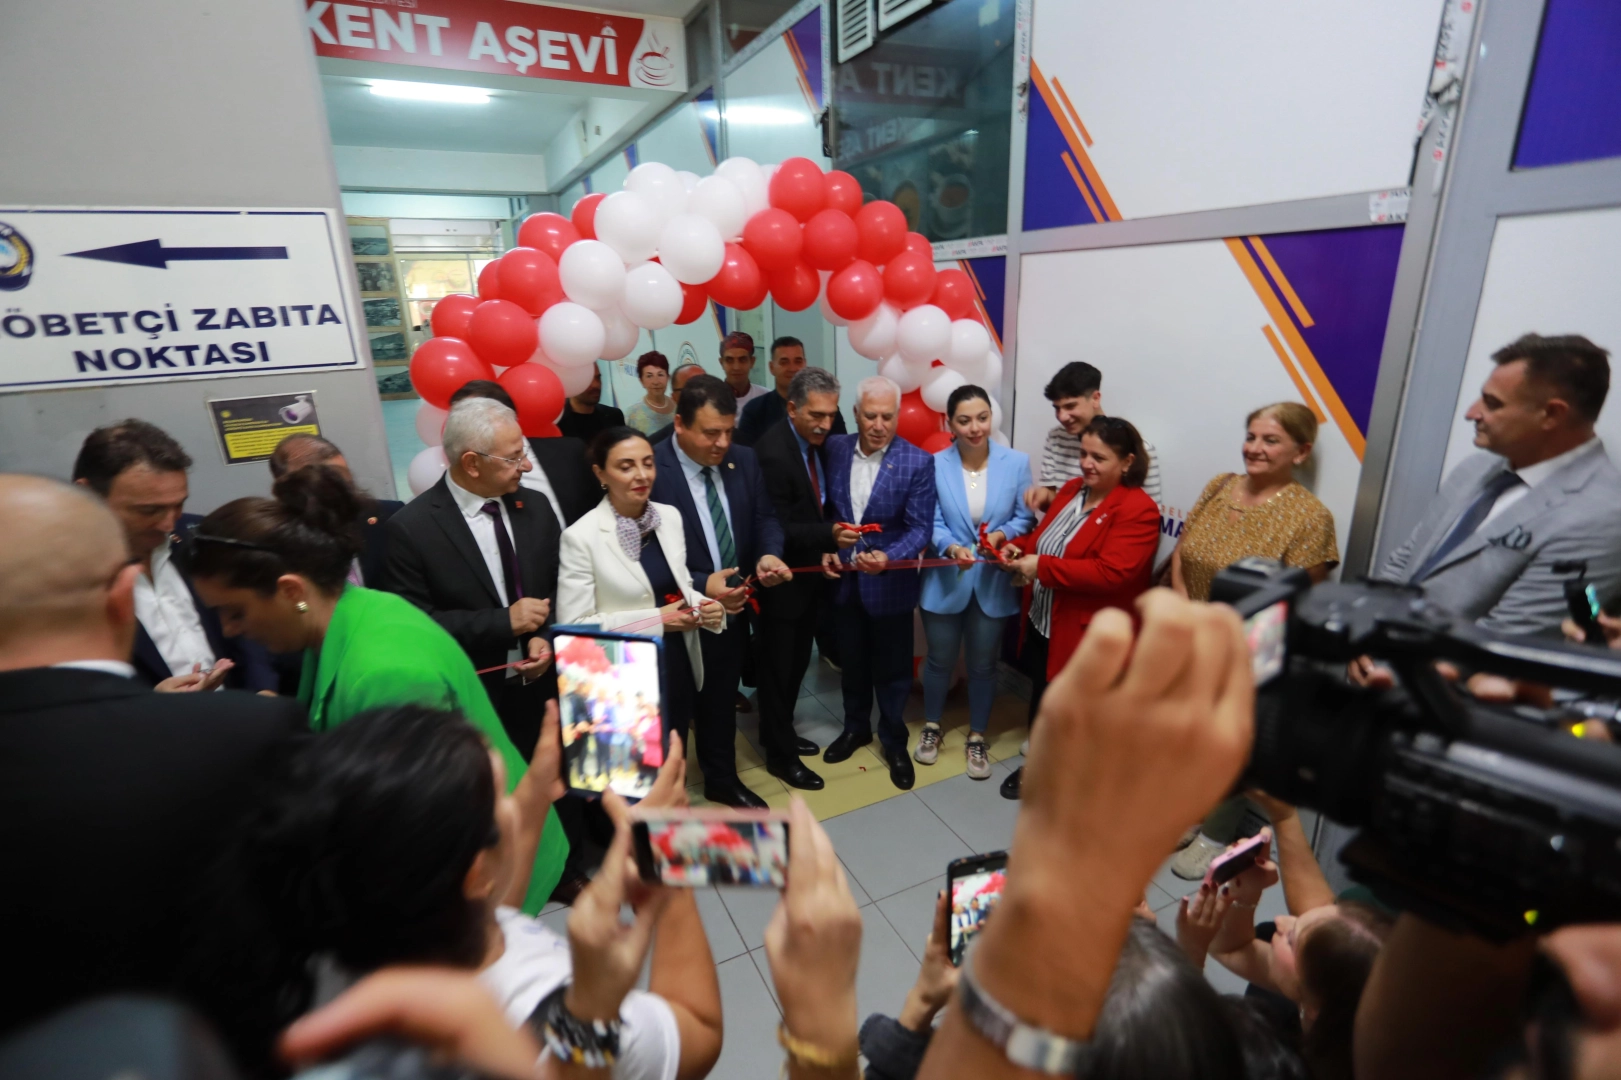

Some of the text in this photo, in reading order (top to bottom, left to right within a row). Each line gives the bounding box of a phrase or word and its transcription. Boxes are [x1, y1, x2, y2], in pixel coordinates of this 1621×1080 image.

[304, 0, 450, 57] KENT
[0, 303, 342, 339] ÖBETÇİ ZABITA
[73, 341, 270, 373] NOKTASI
